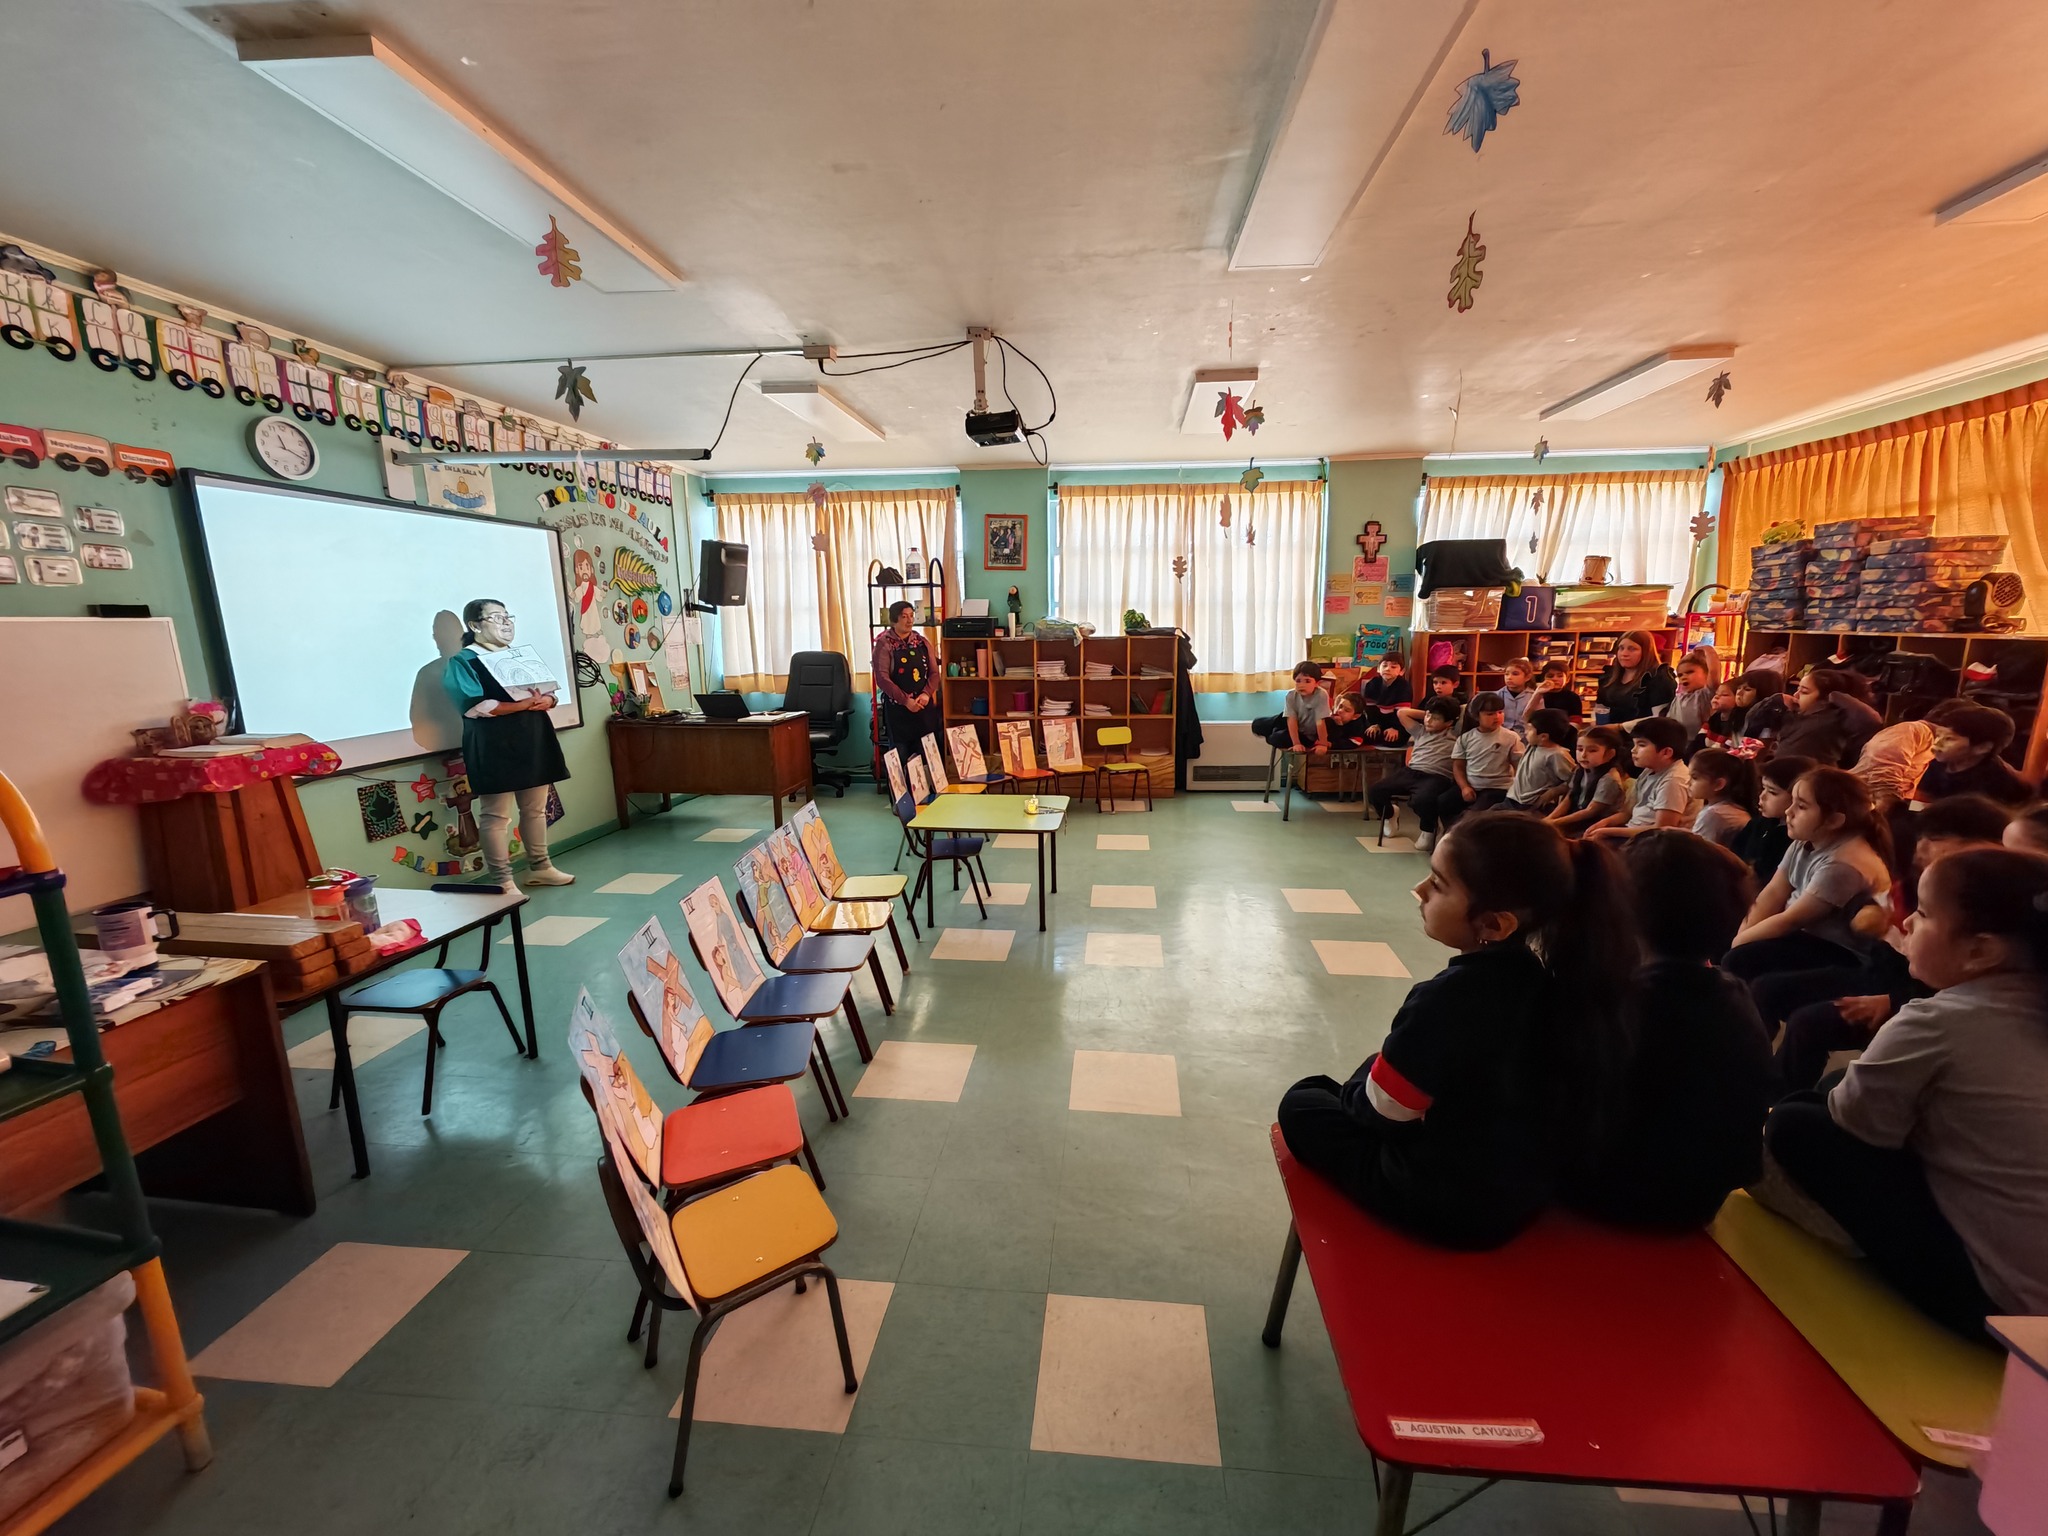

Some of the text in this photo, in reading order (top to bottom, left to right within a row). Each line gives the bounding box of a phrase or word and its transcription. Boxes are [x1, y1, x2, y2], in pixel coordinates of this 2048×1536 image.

[4, 300, 61, 337] K k
[168, 349, 219, 380] M m
[235, 368, 275, 395] N n
[50, 439, 105, 454] Noviembre
[122, 453, 167, 466] Diciembre
[537, 485, 669, 552] PROYECTO DE AULA
[1525, 595, 1537, 623] 1
[1365, 640, 1387, 649] TODO
[683, 897, 696, 915] IV
[641, 925, 657, 949] III
[581, 995, 594, 1020] II
[1410, 1423, 1466, 1435] AGUSTINA
[1472, 1426, 1533, 1438] CAYUQUEO
